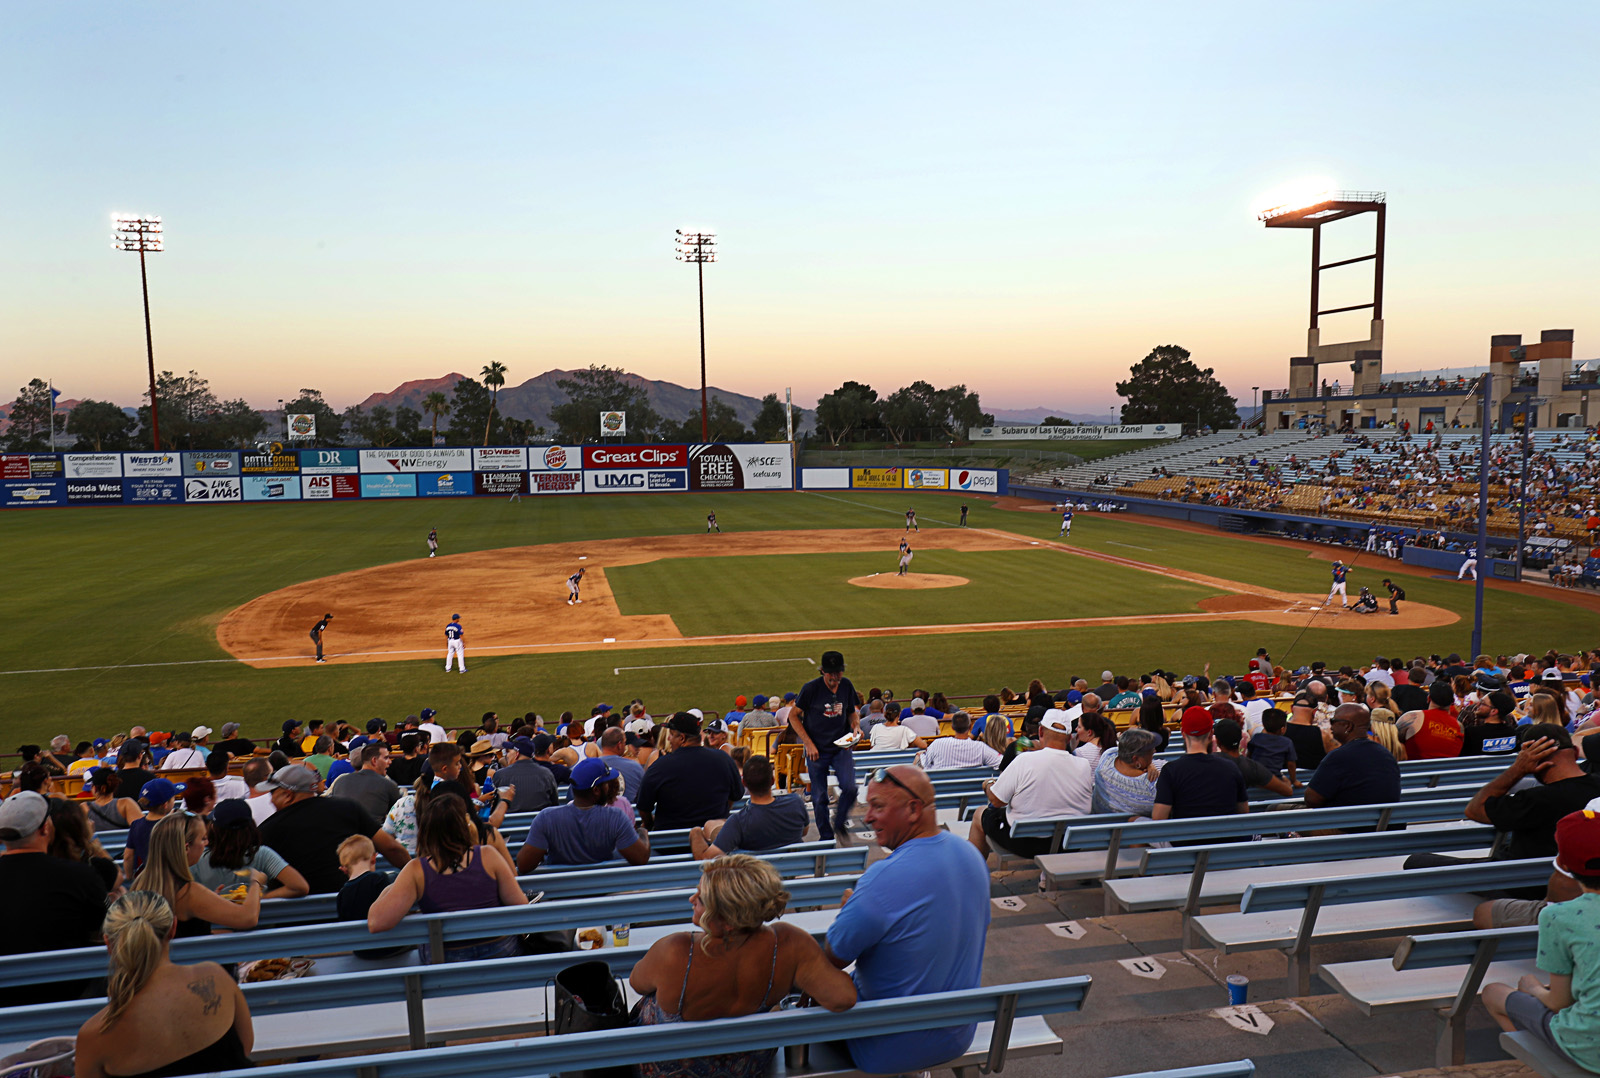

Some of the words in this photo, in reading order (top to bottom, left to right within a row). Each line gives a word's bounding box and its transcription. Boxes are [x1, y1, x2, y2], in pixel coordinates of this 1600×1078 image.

[1001, 427, 1028, 435] Subaru
[1029, 426, 1037, 434] of
[1039, 426, 1052, 434] Las
[1053, 426, 1075, 435] Vegas
[1077, 425, 1101, 435] Family
[1103, 425, 1118, 434] Fun
[1119, 425, 1143, 434] Zone!
[318, 450, 342, 464] DR
[546, 450, 566, 460] BURGER
[546, 454, 566, 466] KING
[592, 450, 638, 463] Great
[640, 449, 678, 465] Clips
[699, 454, 733, 463] TOTALLY
[760, 456, 775, 466] SCE
[700, 462, 734, 474] FREE
[532, 473, 582, 482] TERRIBLE
[753, 470, 782, 479] scefcu.org
[309, 476, 330, 487] AIS
[537, 480, 577, 492] HERBST
[973, 475, 995, 487] pepsi
[68, 484, 96, 492] Honda
[1003, 899, 1017, 907] S
[1059, 925, 1073, 934] T
[1134, 961, 1154, 973] U
[1234, 1013, 1259, 1028] V
